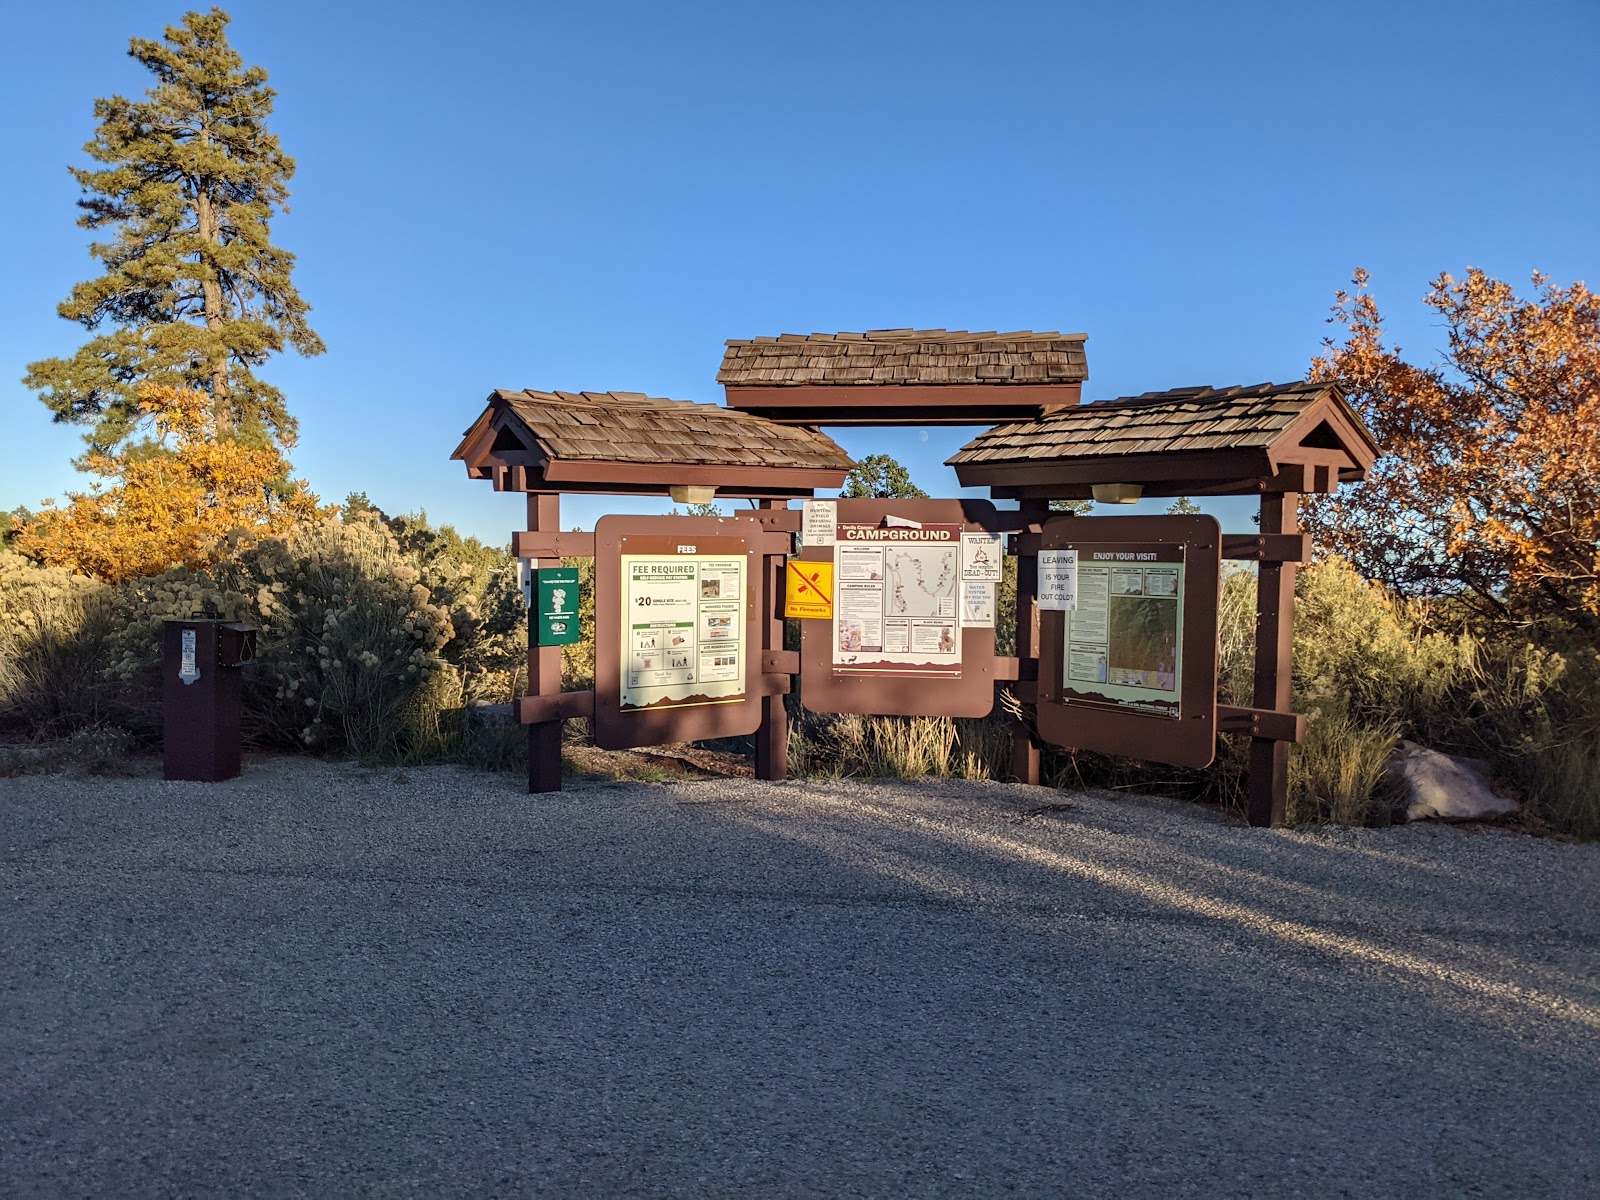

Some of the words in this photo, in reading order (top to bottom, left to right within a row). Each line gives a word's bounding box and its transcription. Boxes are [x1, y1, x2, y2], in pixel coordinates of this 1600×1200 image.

[846, 530, 951, 540] CAMPGROUND
[968, 537, 996, 545] WANTED
[677, 545, 697, 554] FEES
[1042, 556, 1074, 564] LEAVING
[1093, 552, 1115, 560] ENJOY
[1115, 552, 1135, 561] YOUR
[1135, 552, 1157, 561] VISIT!
[633, 565, 649, 574] FEE
[651, 565, 695, 575] REQUIRED
[1040, 593, 1054, 601] OUT
[1054, 594, 1074, 602] COLD?
